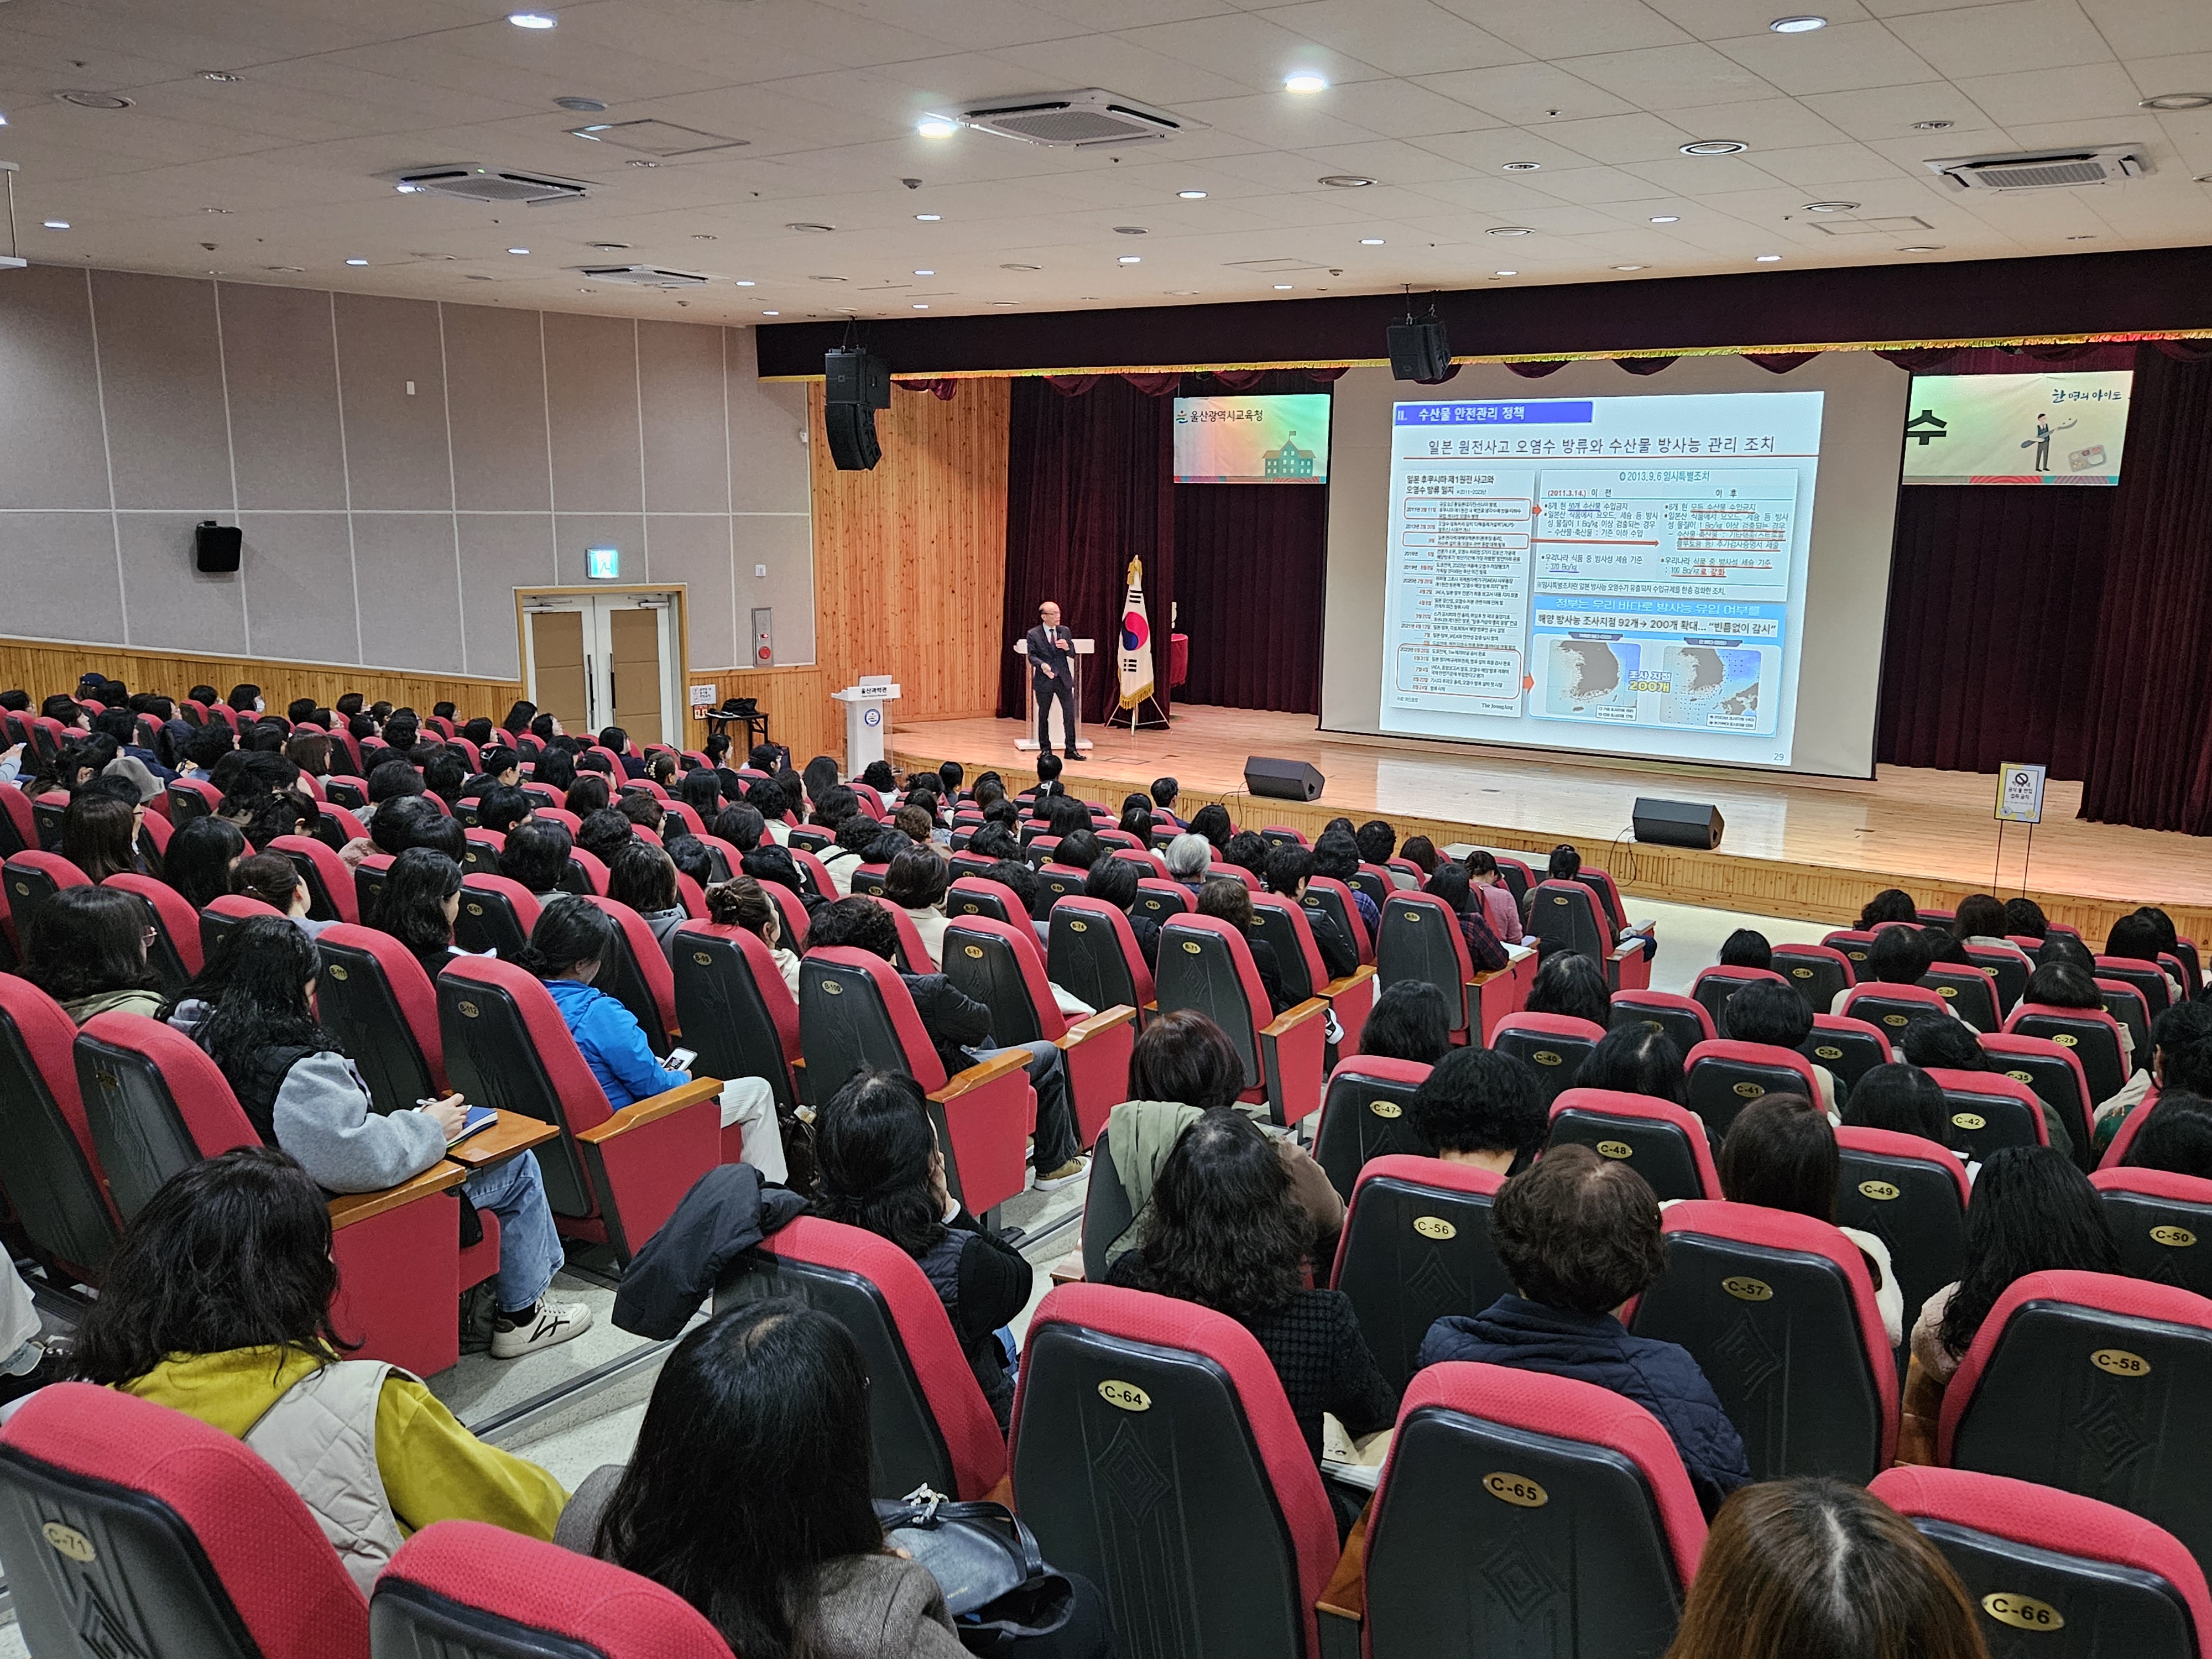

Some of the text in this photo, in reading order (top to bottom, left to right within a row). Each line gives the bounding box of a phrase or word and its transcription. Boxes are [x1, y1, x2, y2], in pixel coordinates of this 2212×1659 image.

[2052, 389, 2065, 403] 한
[2068, 390, 2089, 401] 명의
[1190, 409, 1263, 422] 울산광역시교육청
[1418, 408, 1451, 422] 수산물
[1454, 406, 1498, 421] 안전관리
[1502, 406, 1525, 420] 정책
[1429, 436, 1776, 455] 일본 원전사고 오염수 방류와 수산물 방사능 관리 조치
[1715, 489, 1737, 498] 이 후
[1545, 554, 1569, 562] 우리나라
[1593, 599, 1615, 610] 우리
[1619, 601, 1653, 612] 바다로
[1538, 614, 1554, 624] 해양
[1556, 615, 1580, 625] 방사능
[1583, 616, 1616, 627] 조사지점
[1650, 619, 1678, 630] 200개
[1628, 681, 1671, 693] 200개
[1773, 753, 1784, 761] 29
[331, 967, 347, 978] B-111
[825, 983, 841, 992] B-100
[460, 1004, 477, 1014] B-112
[1536, 1053, 1556, 1062] C-40
[1737, 1086, 1759, 1094] C-41
[1374, 1104, 1396, 1114] C-47
[1956, 1117, 1980, 1125] C-42
[1600, 1145, 1626, 1155] C-48
[1864, 1185, 1893, 1196] C-49
[1418, 1221, 1449, 1235] C-56
[2156, 1229, 2189, 1242] C-50
[1728, 1281, 1764, 1296] C-57
[2098, 1354, 2140, 1371] C-58
[1104, 1385, 1142, 1405] C-64
[1490, 1477, 1537, 1500] C-65
[48, 1528, 86, 1554] C-71
[1992, 1598, 2050, 1624] C-66
